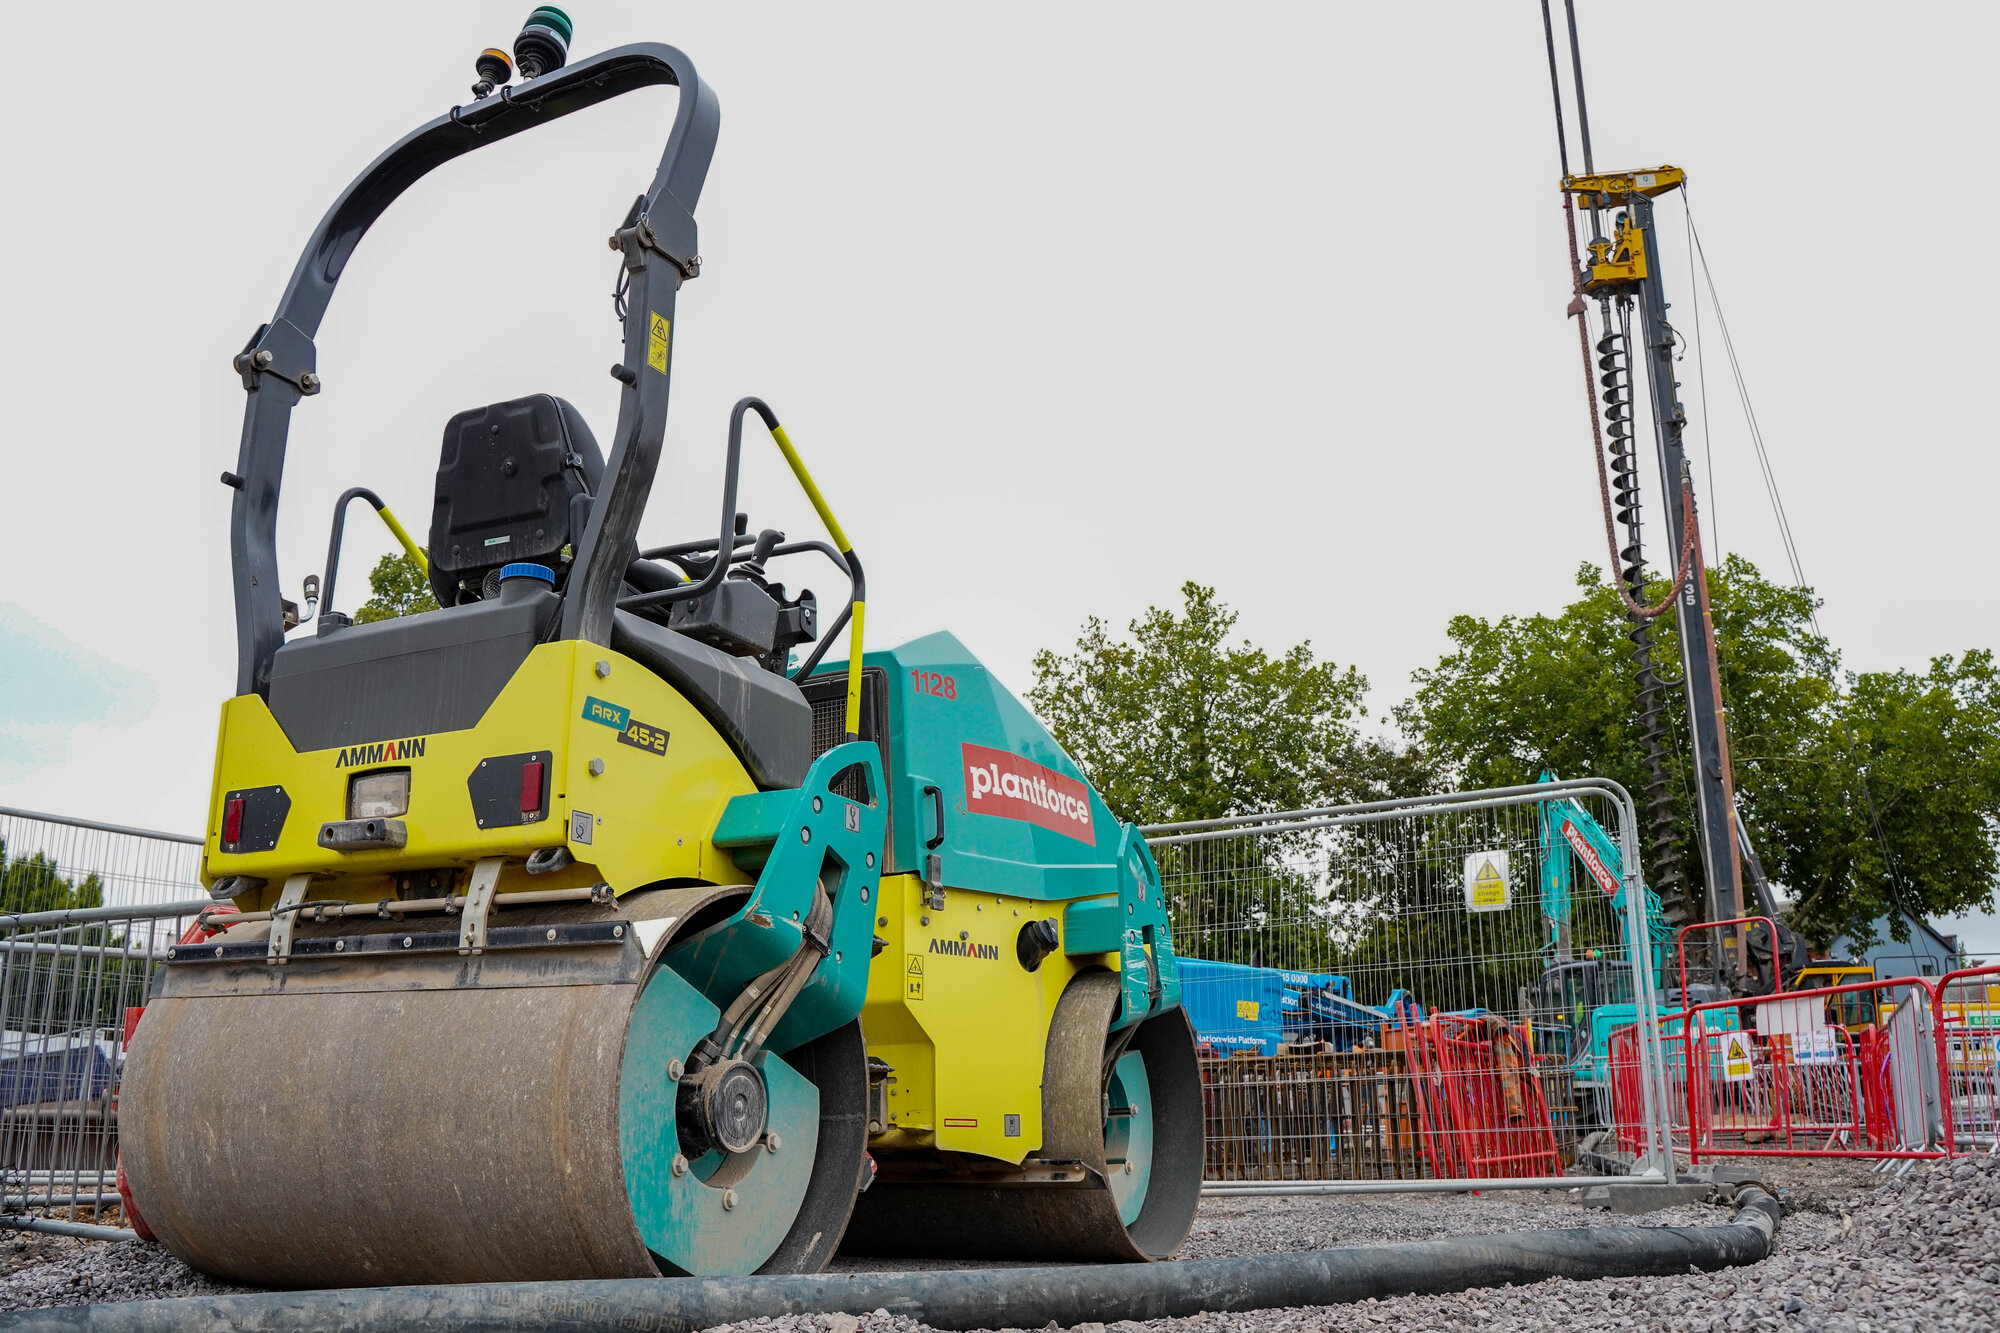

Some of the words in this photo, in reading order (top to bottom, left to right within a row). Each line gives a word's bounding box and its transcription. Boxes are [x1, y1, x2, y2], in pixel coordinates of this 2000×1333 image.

[911, 669, 957, 700] 1128
[591, 704, 621, 724] ARX
[627, 725, 665, 751] 45-2
[335, 738, 426, 768] AMMANN
[969, 763, 1089, 824] plantforce
[1566, 823, 1612, 889] plantforce
[929, 939, 999, 960] AMMANN
[1290, 973, 1308, 984] 0000
[1197, 1034, 1237, 1044] Nationwide
[1238, 1035, 1267, 1045] Platforms
